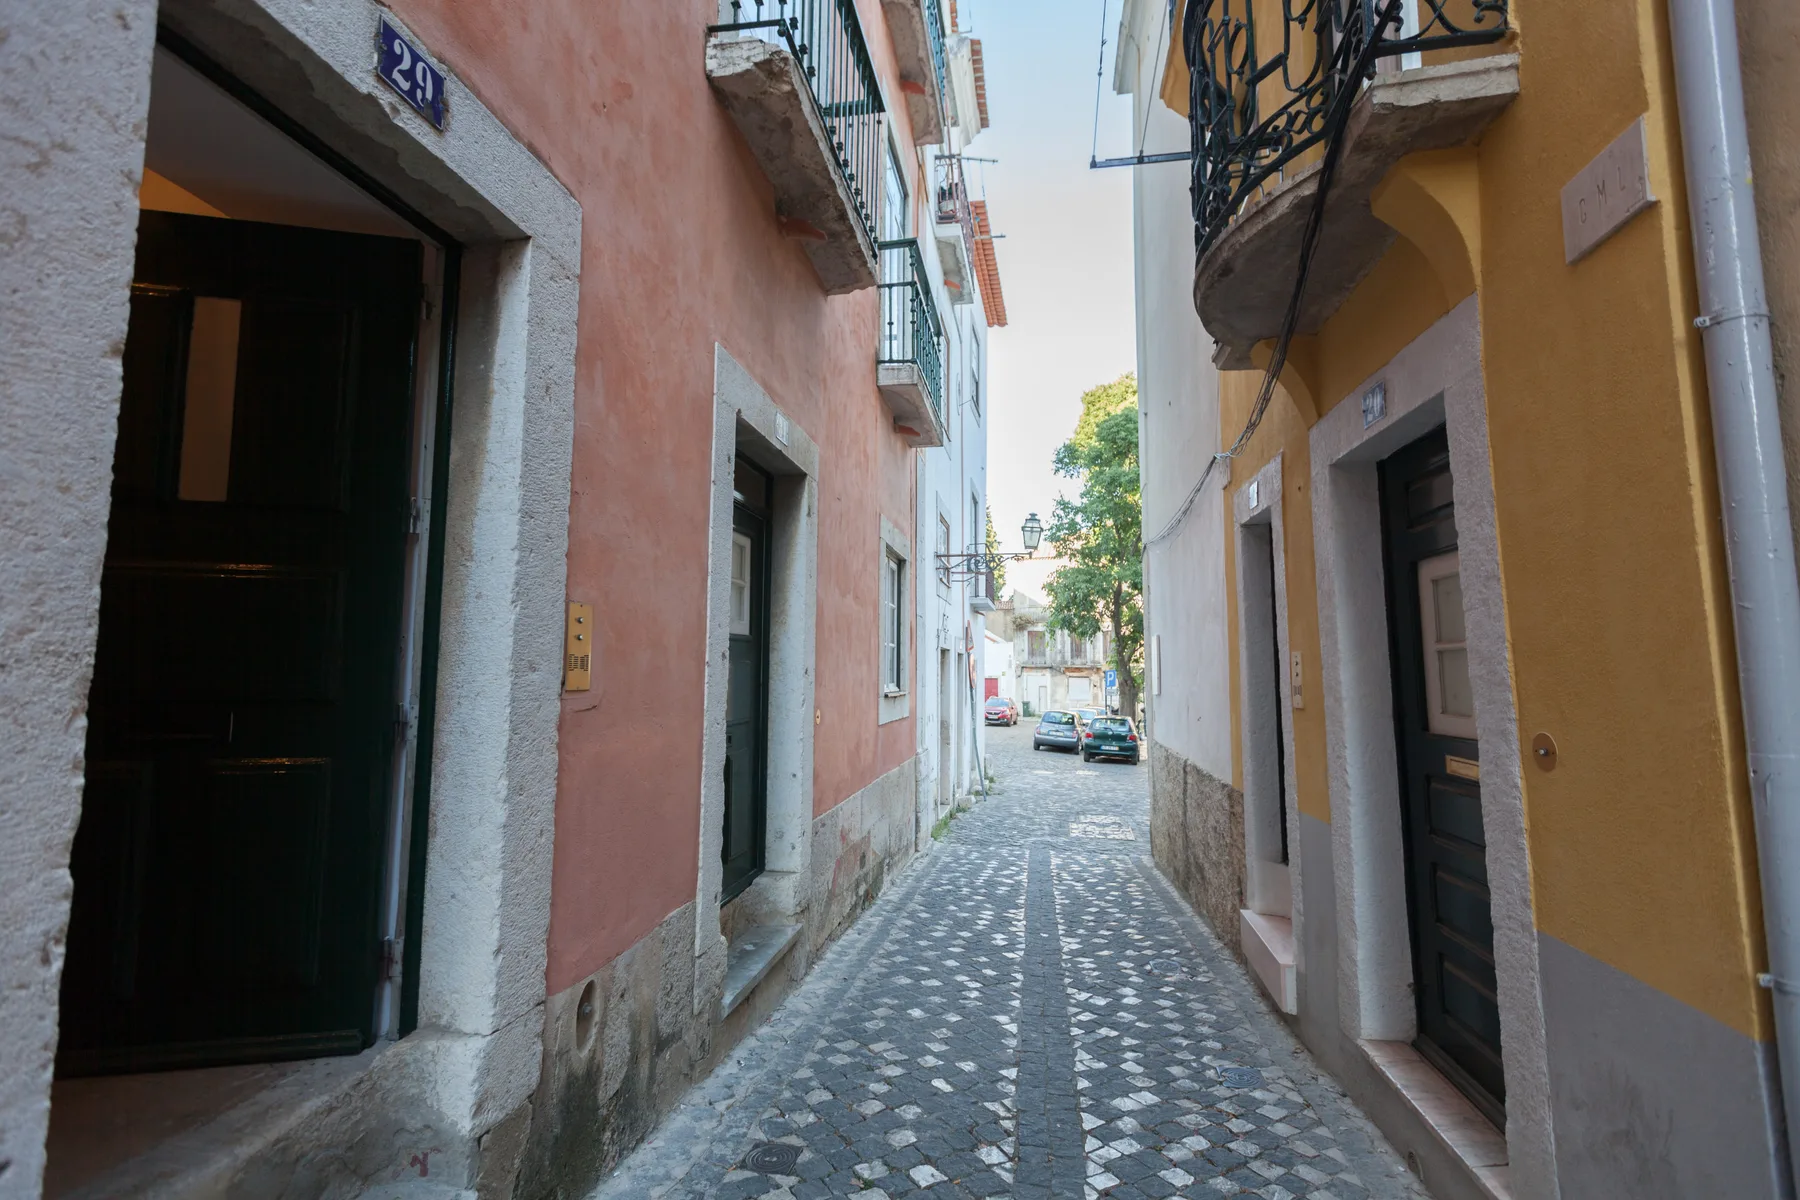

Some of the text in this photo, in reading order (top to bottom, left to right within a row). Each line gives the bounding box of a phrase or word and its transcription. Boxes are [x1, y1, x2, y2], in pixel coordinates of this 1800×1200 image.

[392, 38, 433, 107] 29
[1366, 387, 1380, 421] 20
[1107, 671, 1114, 687] P
